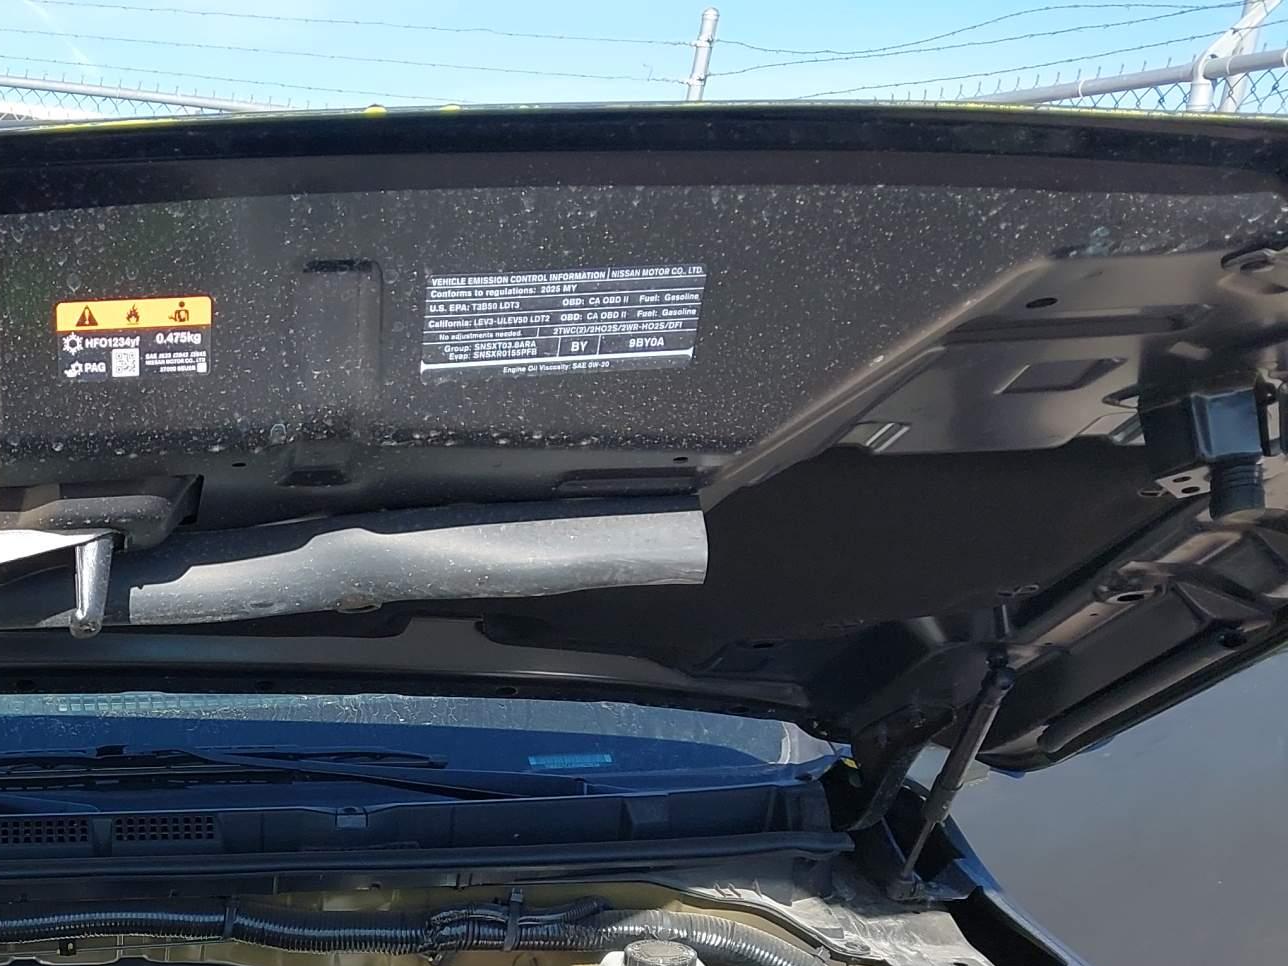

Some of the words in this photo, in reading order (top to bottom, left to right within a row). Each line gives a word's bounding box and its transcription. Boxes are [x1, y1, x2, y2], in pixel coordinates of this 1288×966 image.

[431, 277, 466, 286] VEHICLE
[467, 275, 508, 285] EMISSION
[510, 274, 548, 284] CONTROL
[549, 271, 606, 282] INFORMATION
[611, 269, 640, 279] NISSAN
[642, 267, 670, 277] MOTOR
[430, 289, 472, 298] Conforms
[474, 288, 484, 297] to
[485, 287, 537, 297] regulations:
[540, 285, 560, 294] 2025
[563, 284, 578, 293] MY
[562, 297, 585, 306] OBD:
[588, 296, 601, 305] CA
[602, 296, 621, 304] OBD
[639, 294, 660, 303] Fuel:
[664, 292, 700, 301] Gasoline
[429, 304, 447, 312] U.S.
[449, 303, 470, 312] EPA:
[637, 309, 658, 318] Fuel:
[661, 308, 697, 317] Gasoline
[428, 318, 472, 328] California:
[530, 314, 550, 323] LDT2
[560, 313, 583, 322] OBD:
[587, 312, 599, 320] CA
[600, 311, 620, 319] OBD
[85, 335, 140, 349] HFO1234yf
[155, 331, 202, 345] 0.475kg
[439, 333, 449, 341] No
[451, 332, 493, 340] adjustments
[444, 345, 472, 353] Group:
[570, 340, 588, 352] BY
[449, 352, 472, 361] Evap:
[84, 361, 106, 373] PAG
[503, 366, 526, 374] Engine
